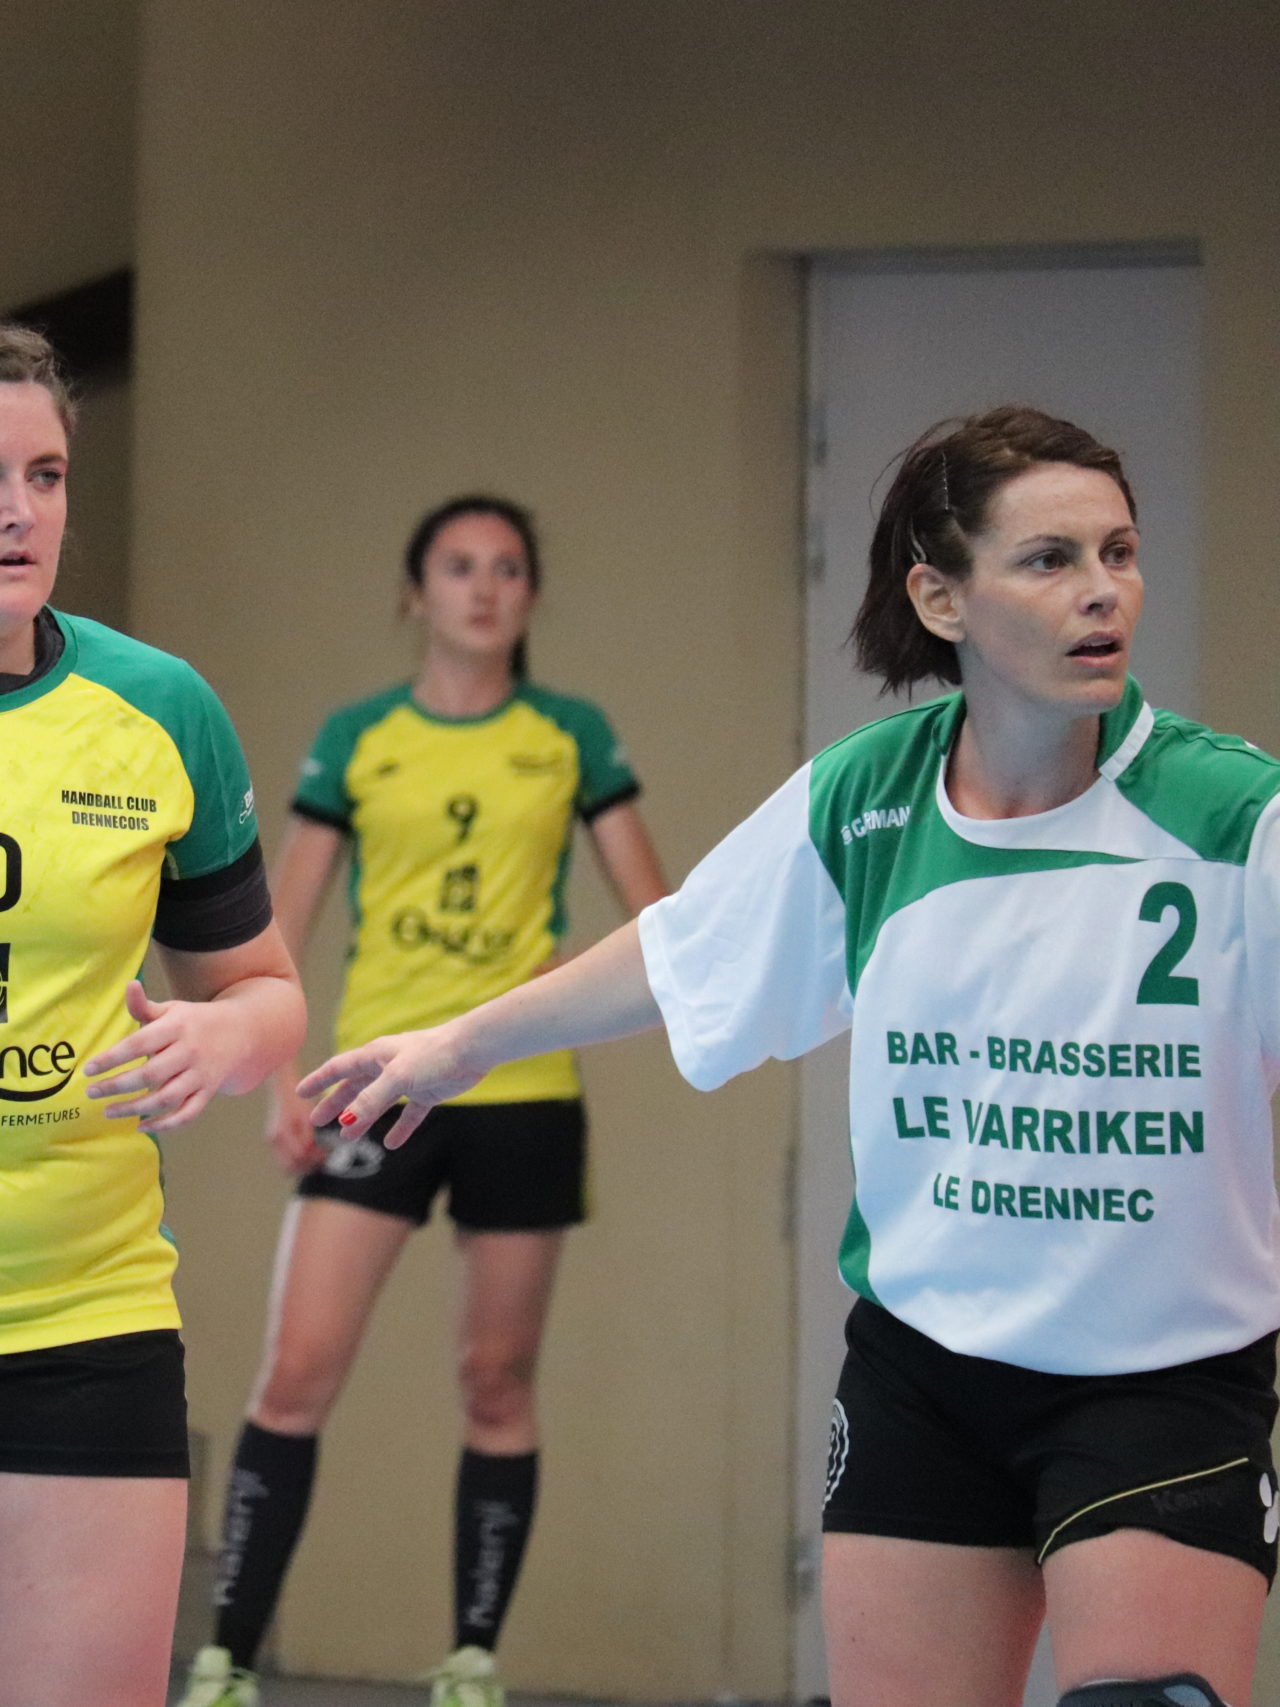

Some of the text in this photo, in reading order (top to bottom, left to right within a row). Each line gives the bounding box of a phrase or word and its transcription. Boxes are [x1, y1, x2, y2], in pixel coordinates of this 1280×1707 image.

[61, 789, 157, 813] HANDBALL CLUB
[72, 811, 150, 831] DRENNECOIS
[446, 794, 479, 842] 9
[1136, 881, 1200, 1006] 2
[886, 1031, 960, 1065] BAR
[986, 1036, 1202, 1077] BRASSERIE
[1, 1107, 80, 1127] FERMETURES
[892, 1096, 1205, 1156] LE VARRIKEN
[933, 1173, 1155, 1223] LE DRENNEC
